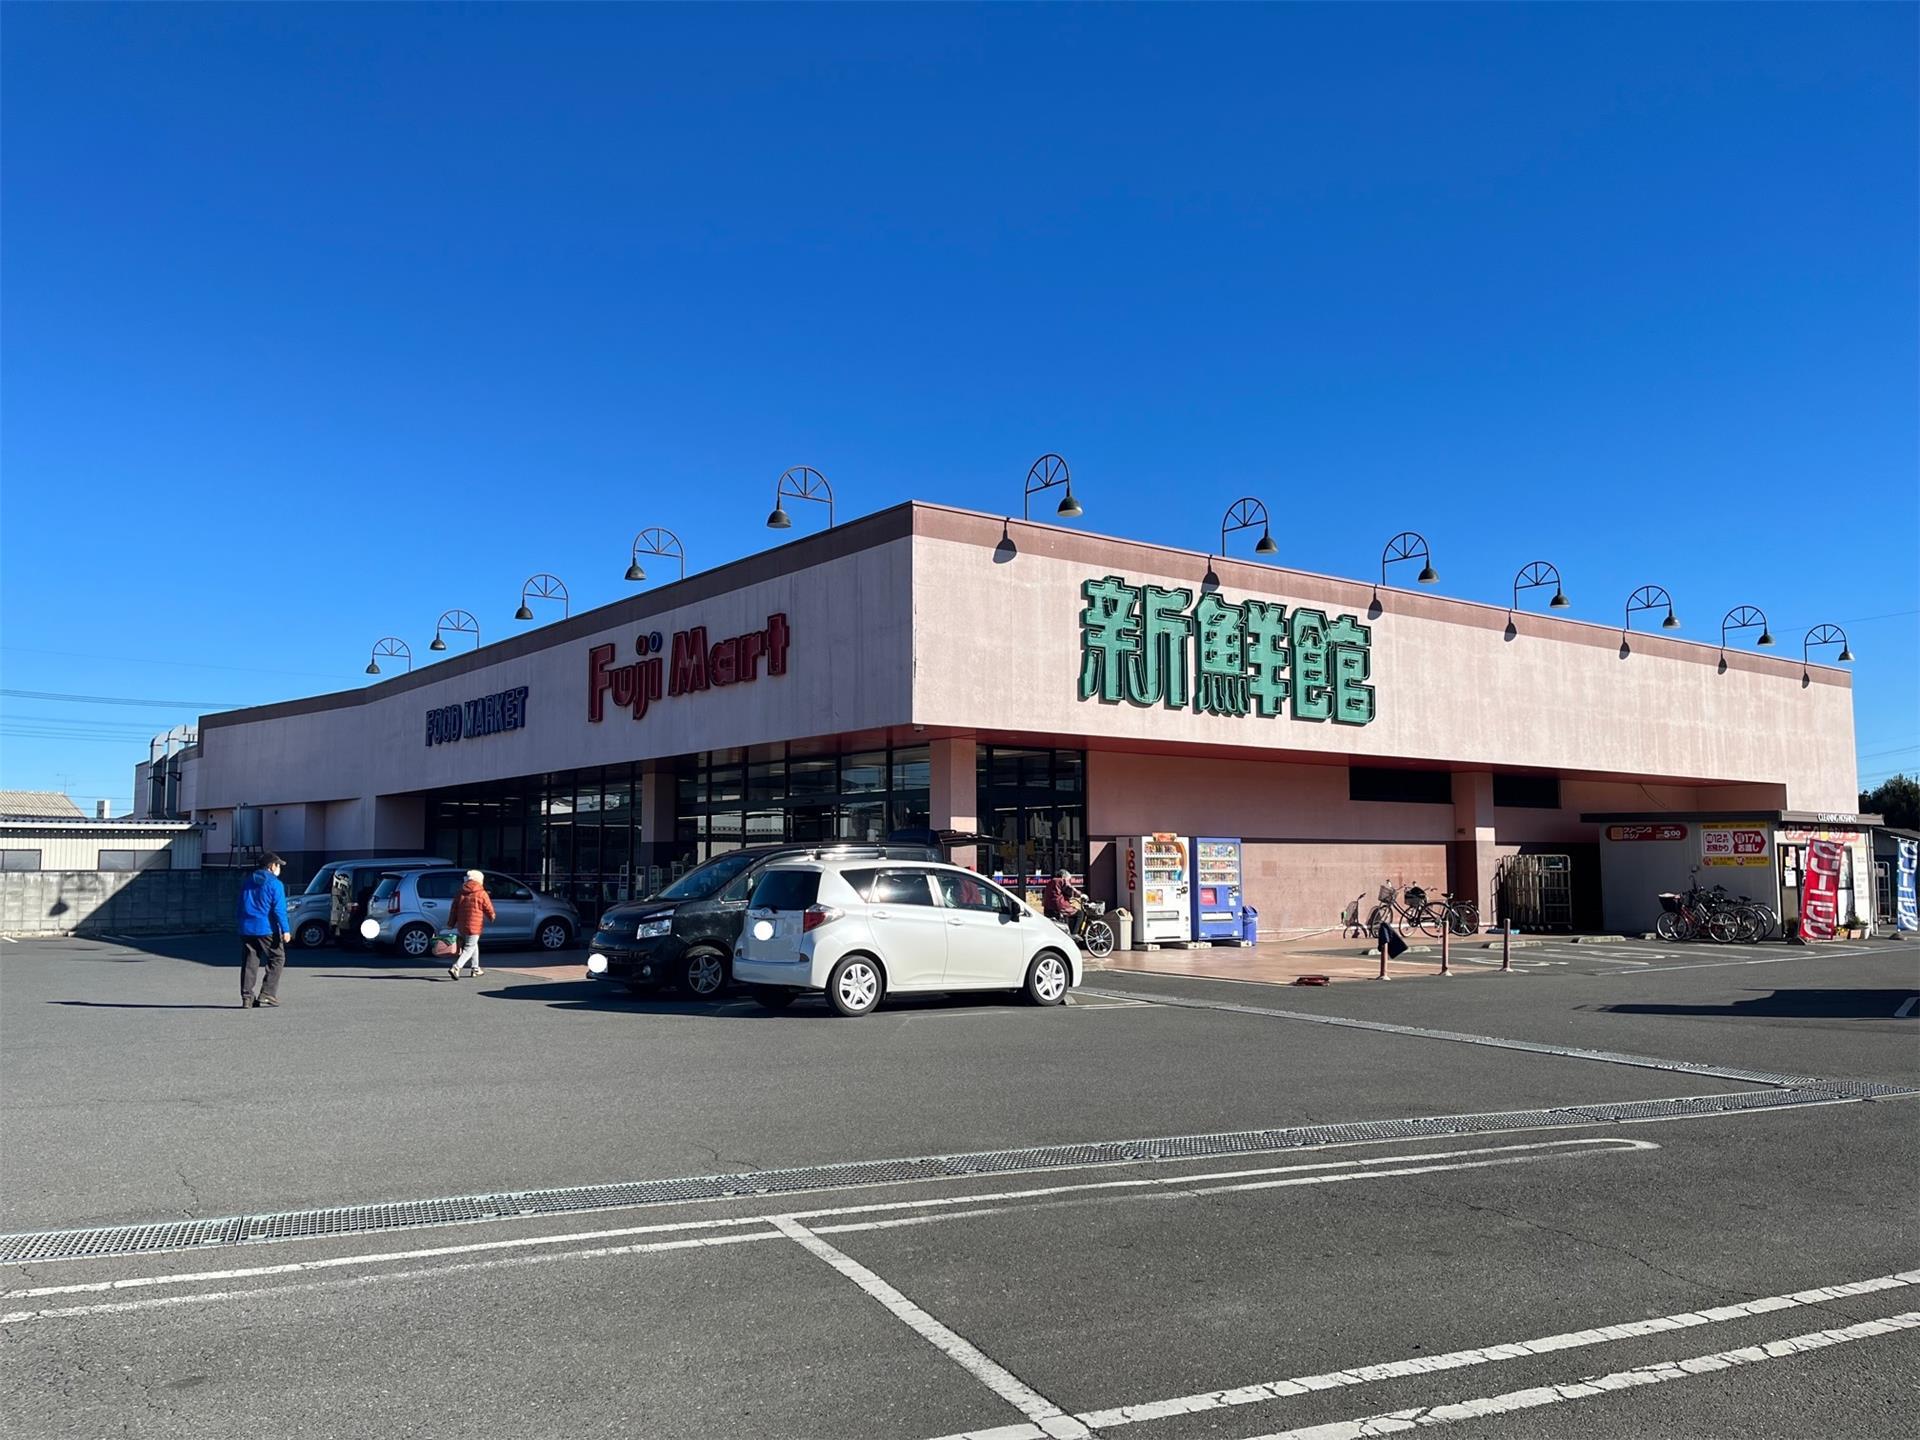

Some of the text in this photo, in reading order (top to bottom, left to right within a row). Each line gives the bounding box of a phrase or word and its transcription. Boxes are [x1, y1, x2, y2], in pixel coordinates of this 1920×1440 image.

[588, 613, 790, 723] Fuji Mart
[1078, 575, 1376, 727] 新鮮館
[426, 686, 529, 747] FOOD MARKET
[1128, 850, 1138, 891] DyDo
